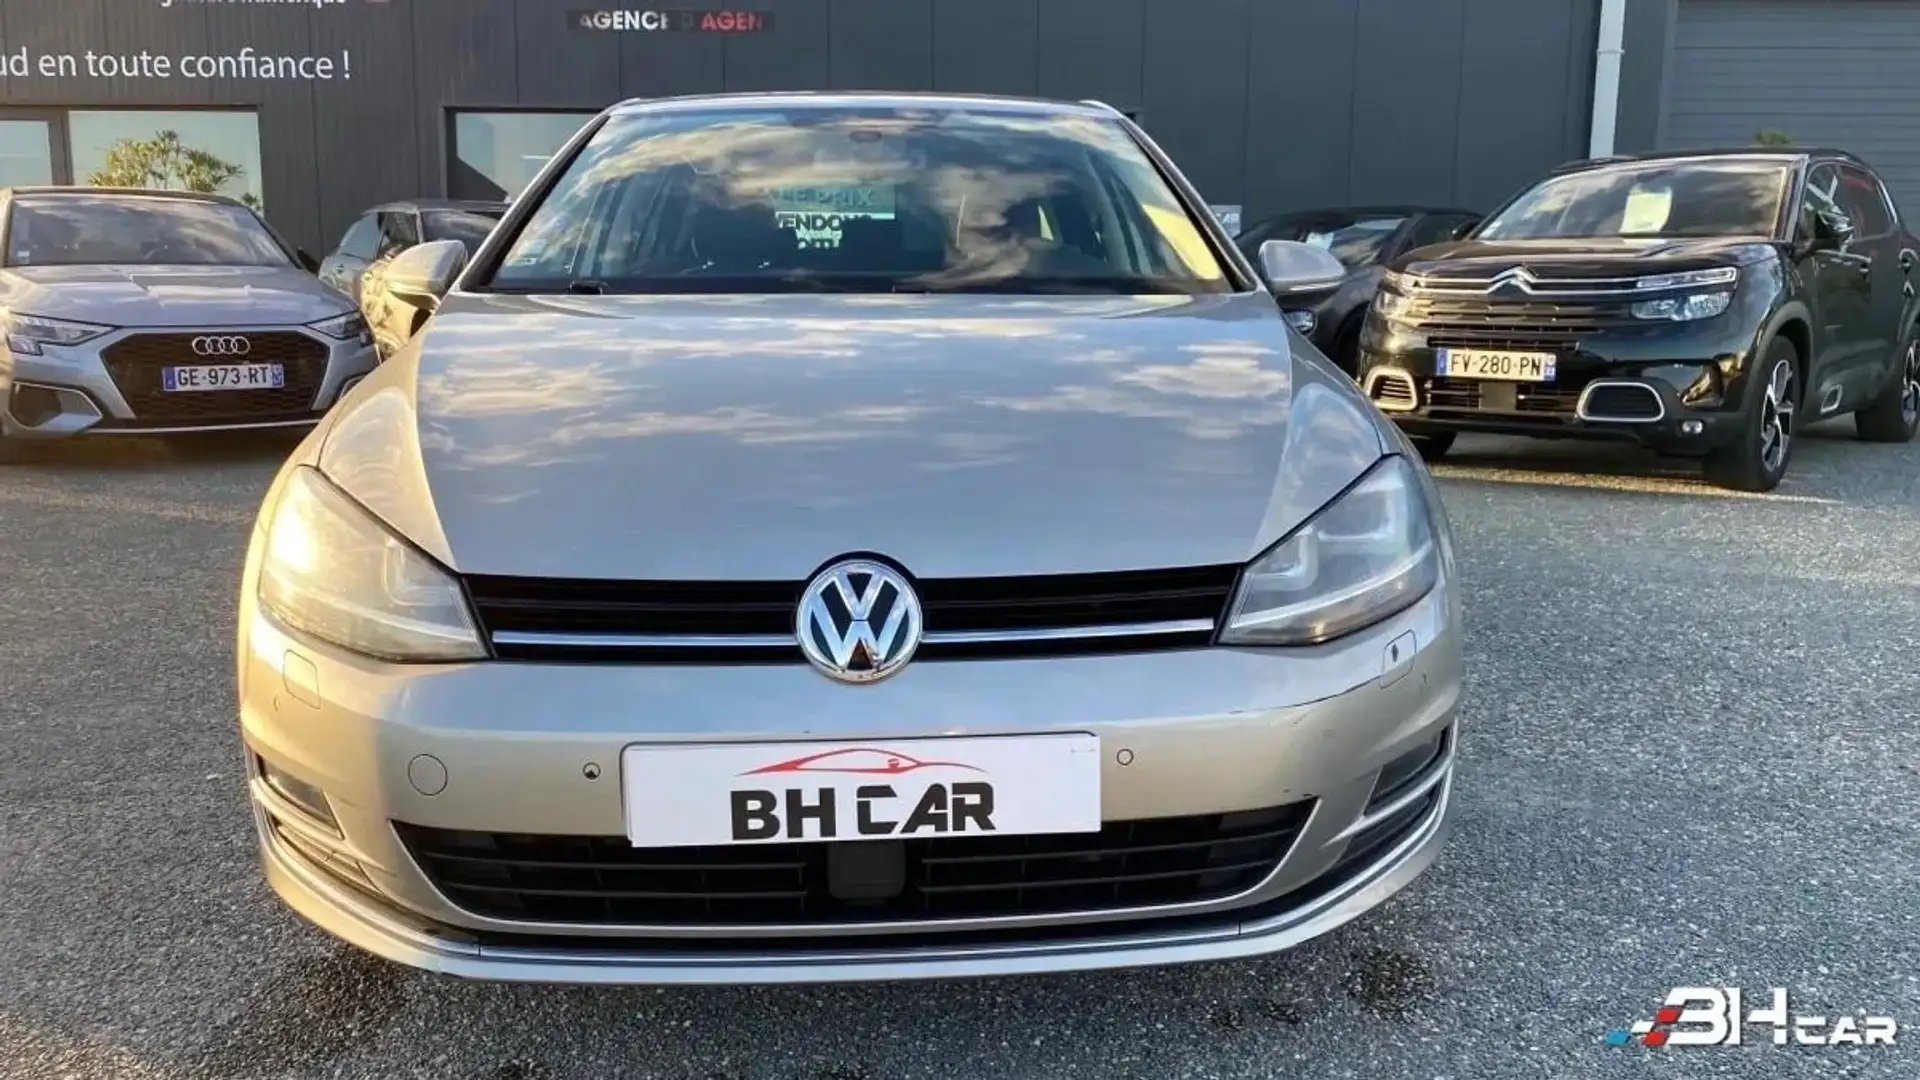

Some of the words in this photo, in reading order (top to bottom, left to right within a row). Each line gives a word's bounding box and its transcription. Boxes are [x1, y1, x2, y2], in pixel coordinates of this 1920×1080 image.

[580, 10, 669, 30] AGENCE
[39, 54, 76, 77] en
[85, 50, 171, 78] toute
[180, 48, 333, 79] confiance
[343, 50, 351, 79] !
[178, 366, 269, 386] GE-973-RT
[1451, 353, 1541, 377] FV-280-PN
[731, 788, 837, 841] BH
[856, 782, 997, 835] CAR
